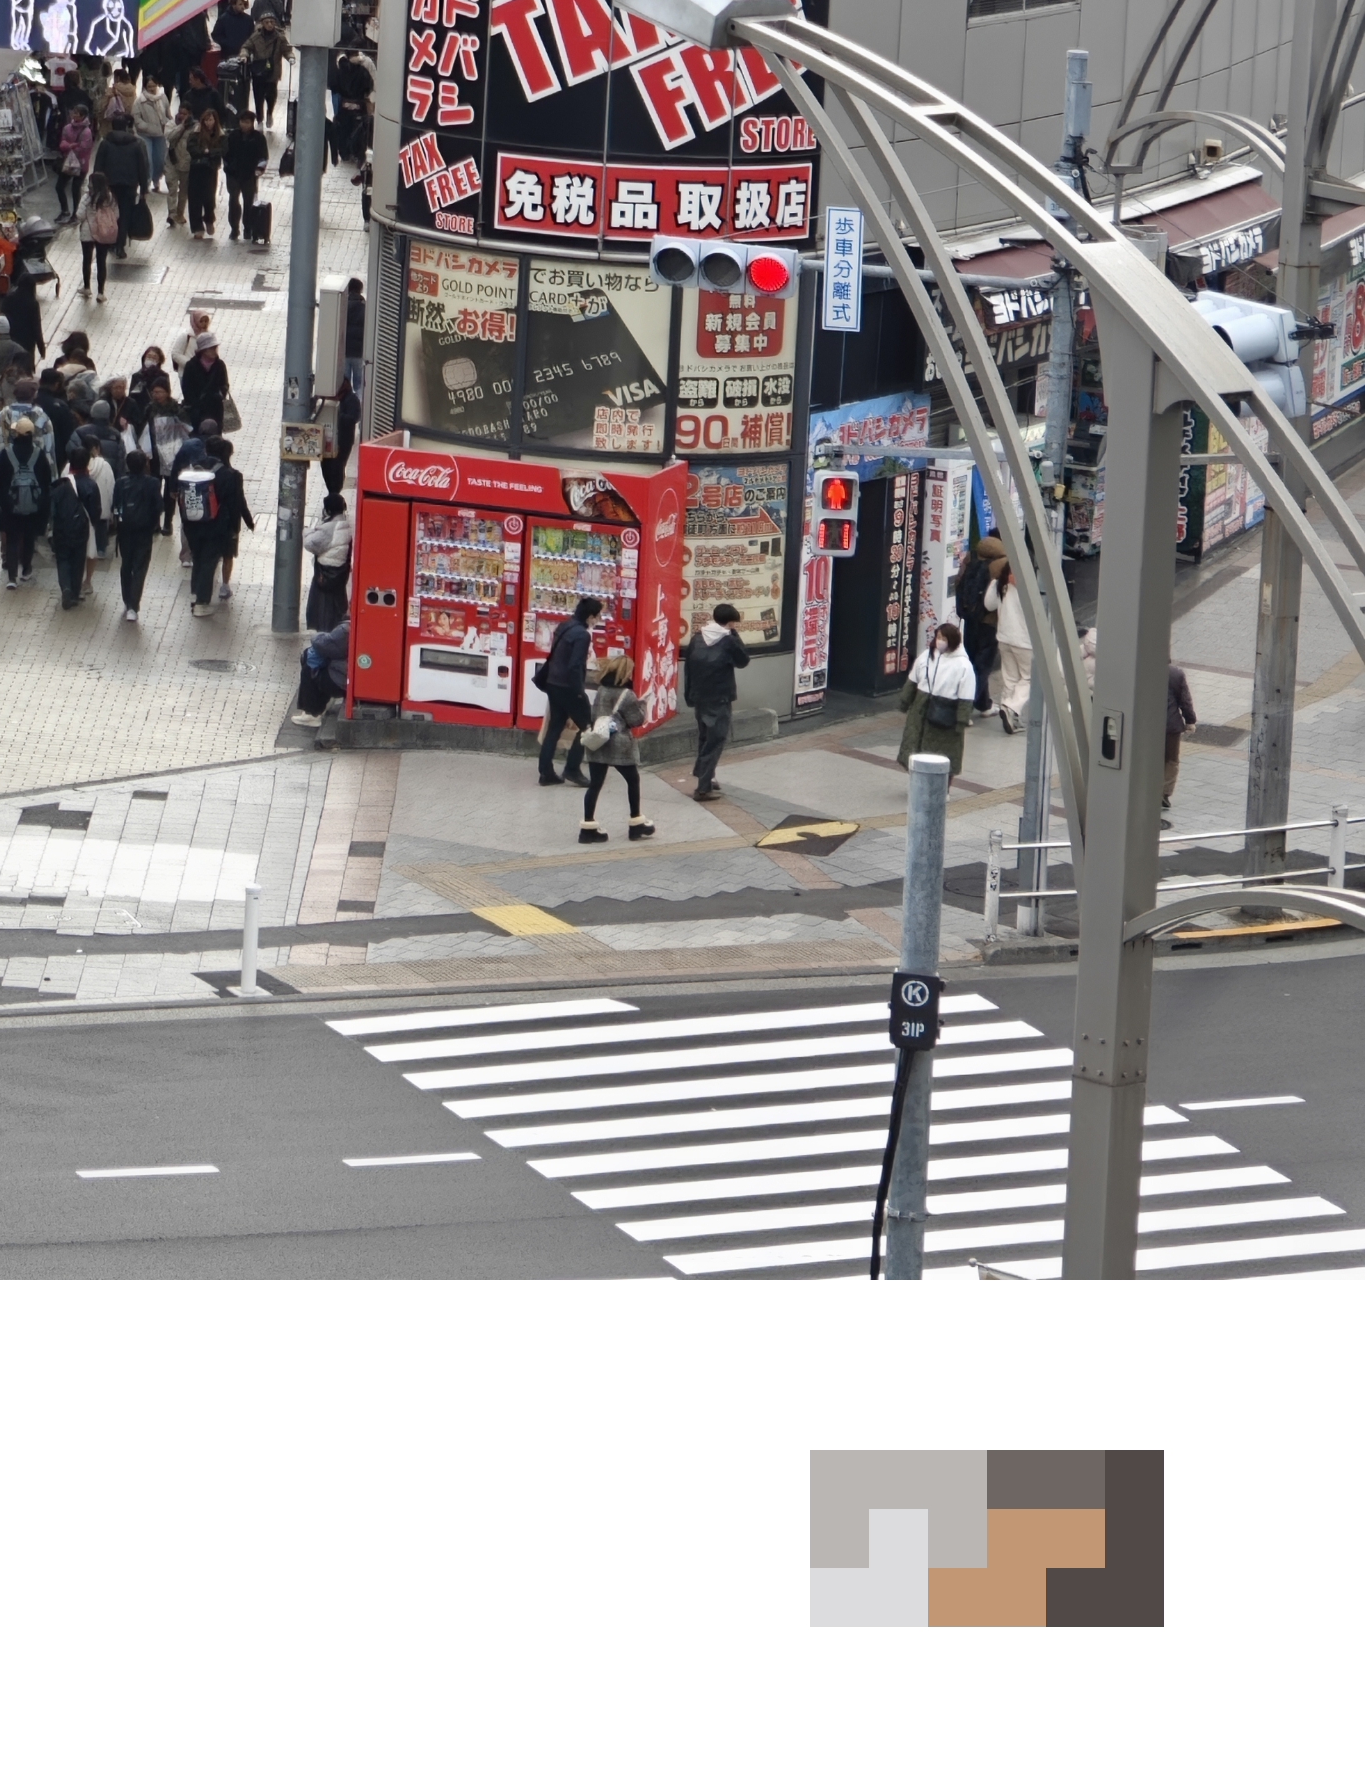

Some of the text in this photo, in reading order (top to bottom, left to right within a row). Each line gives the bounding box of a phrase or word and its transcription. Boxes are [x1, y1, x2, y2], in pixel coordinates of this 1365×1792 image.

[739, 116, 816, 154] STORE
[399, 131, 447, 188] TAX
[424, 158, 482, 213] FREE
[503, 169, 809, 231] 免税品取扱店
[435, 212, 475, 234] STORE
[1200, 226, 1263, 274] ヨドバシカメラ
[410, 246, 659, 292] ヨドバシカメラ でお買い物なら
[832, 217, 854, 323] 歩車分離式
[442, 278, 515, 300] GOLD POINT
[992, 288, 1054, 325] ヨドバシ
[705, 312, 776, 331] 新規会員
[715, 333, 768, 353] 募集中
[534, 363, 573, 383] 2345
[582, 352, 622, 371] 6789
[602, 379, 660, 407] VISA
[679, 379, 717, 399] 盗難
[725, 378, 757, 398] 破損
[763, 377, 791, 395] 水没
[595, 406, 640, 422] 店内で
[689, 398, 705, 407] から
[734, 398, 748, 407] から
[594, 423, 655, 437] 即時発行
[840, 408, 929, 444] ヨドバシカメラ
[593, 437, 662, 453] 致します!
[389, 462, 455, 489] Coca-Cola
[467, 478, 544, 493] TASTE THE FEELING
[686, 473, 787, 508] 2号店のご案内
